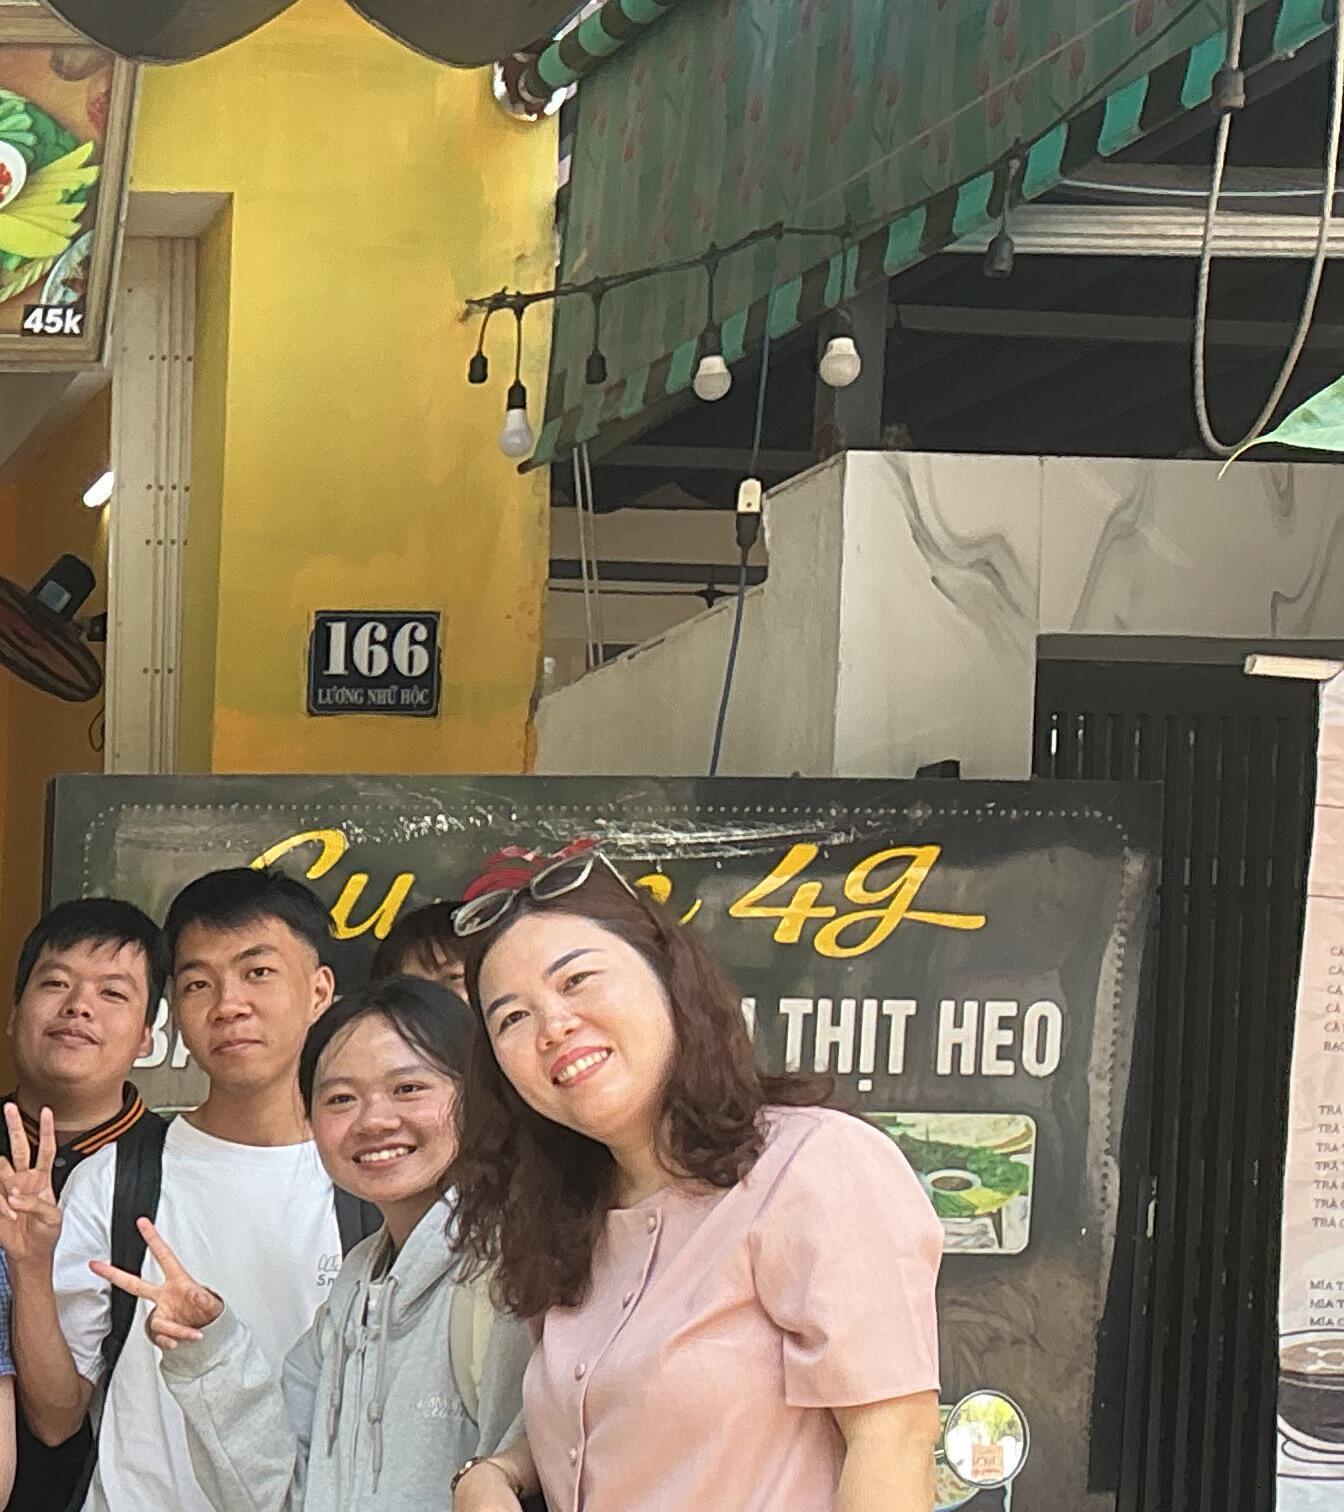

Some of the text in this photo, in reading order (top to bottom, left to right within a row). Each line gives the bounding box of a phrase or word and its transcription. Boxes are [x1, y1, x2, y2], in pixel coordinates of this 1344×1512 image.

[24, 309, 82, 336] 45k
[323, 621, 429, 677] 166
[729, 844, 986, 958] 4g
[778, 998, 917, 1091] THỊT
[936, 1000, 1062, 1077] HEO
